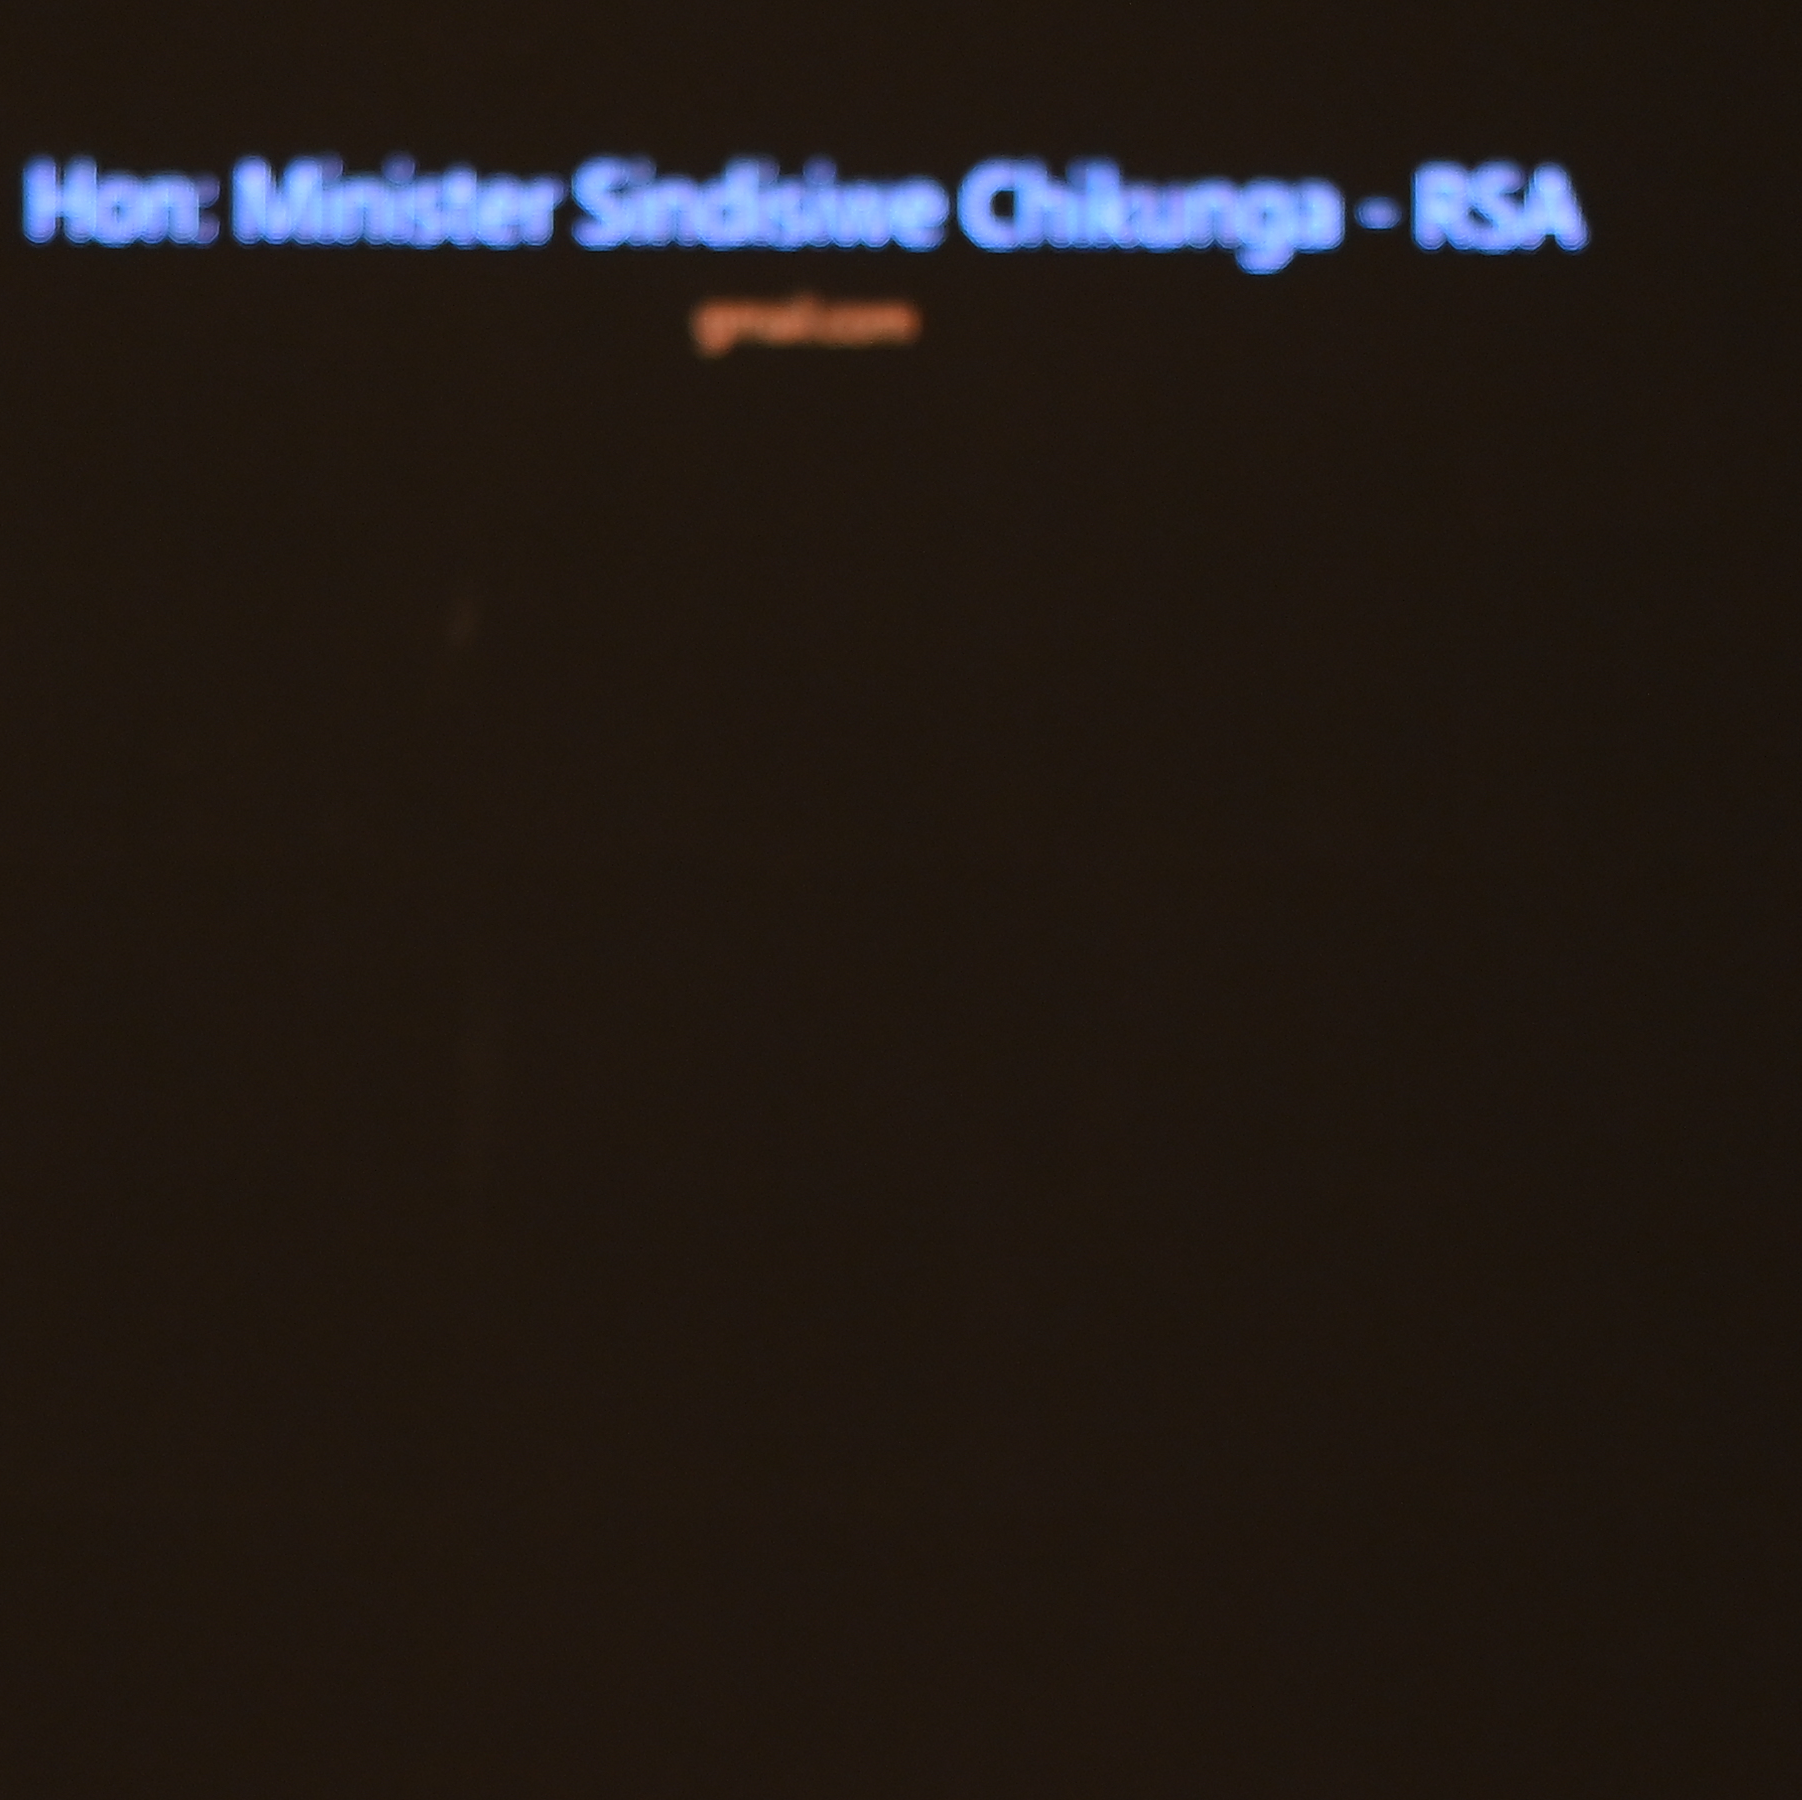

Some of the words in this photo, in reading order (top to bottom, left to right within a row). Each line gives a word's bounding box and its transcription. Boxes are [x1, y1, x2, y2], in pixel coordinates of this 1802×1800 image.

[24, 159, 218, 247] Hon:
[232, 157, 566, 249] Minister
[571, 157, 950, 251] Sindisiwe
[957, 159, 1344, 273] Chikunga
[1412, 162, 1587, 253] RSA
